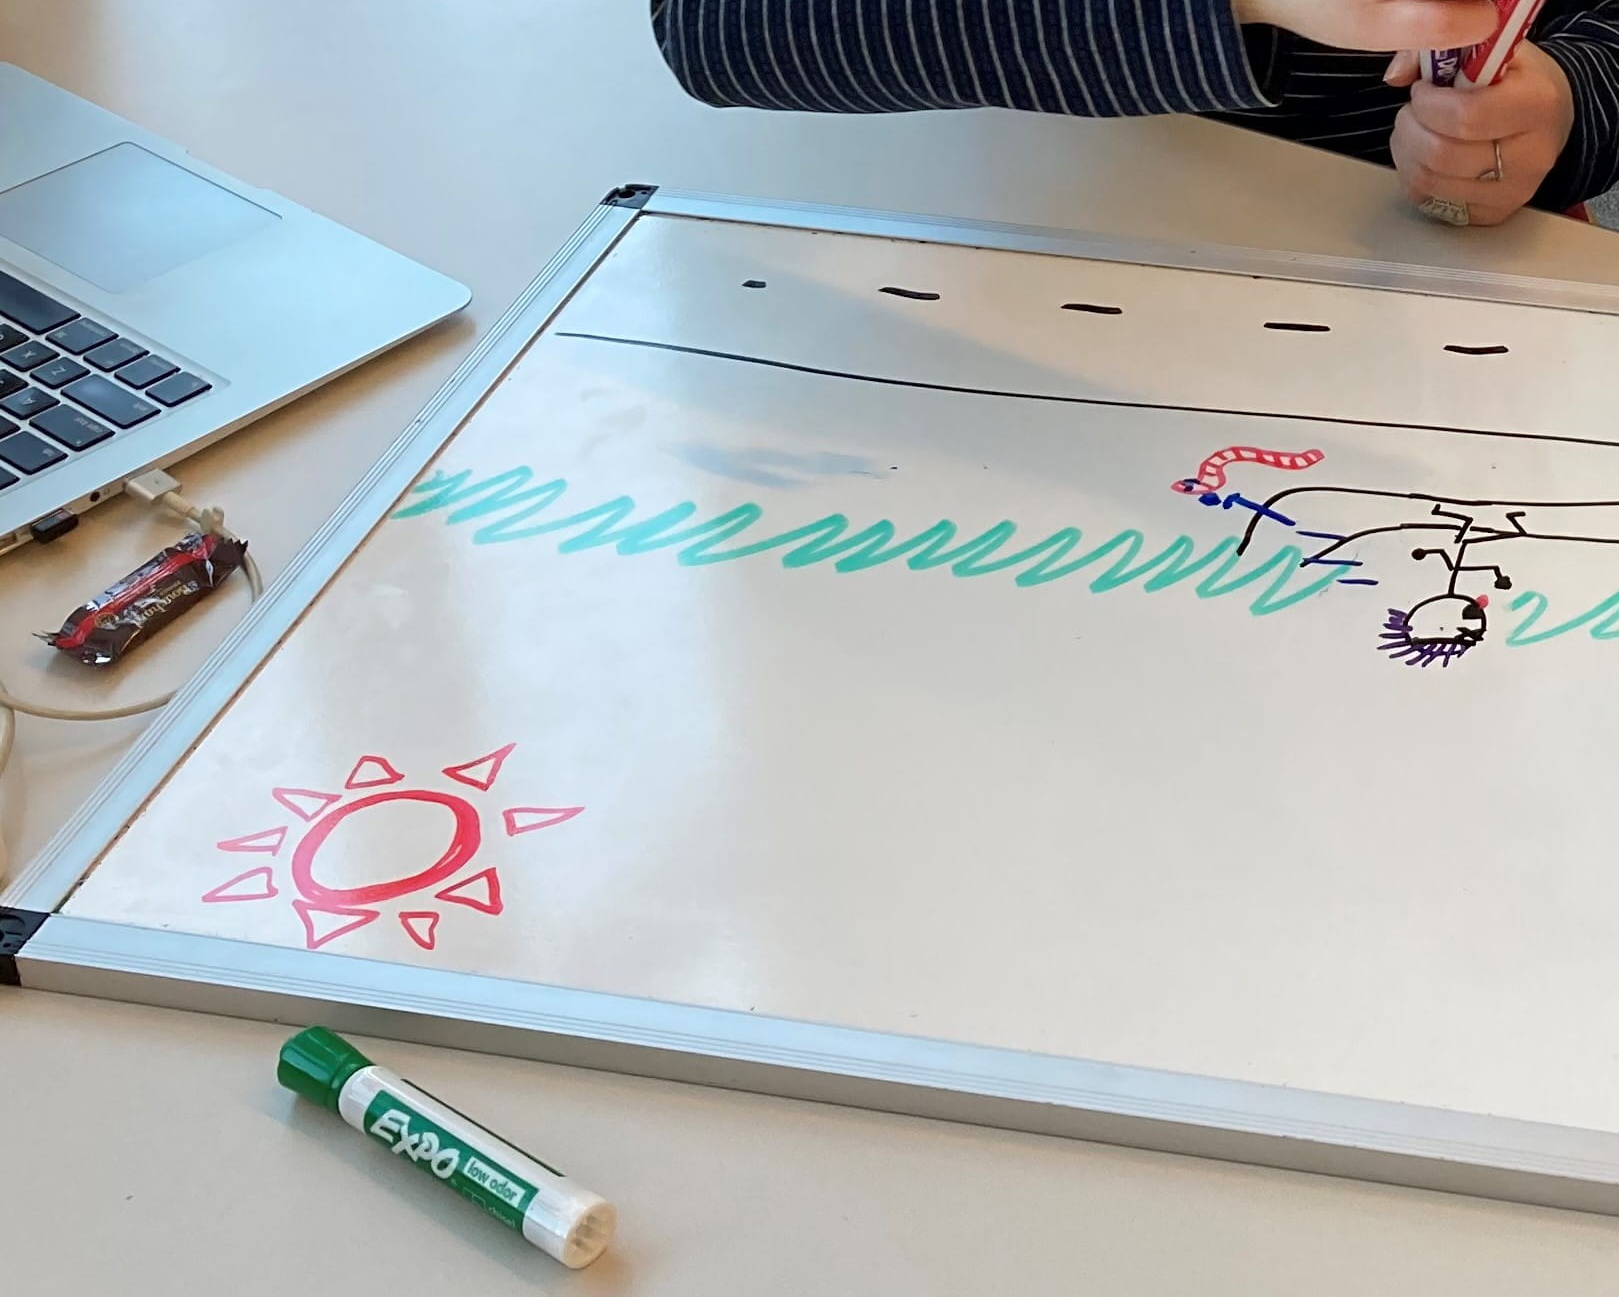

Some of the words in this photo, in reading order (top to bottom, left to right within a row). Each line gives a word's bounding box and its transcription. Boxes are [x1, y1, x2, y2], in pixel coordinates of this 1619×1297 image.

[370, 1108, 460, 1180] EXPO
[467, 1160, 491, 1184] low
[489, 1179, 518, 1202] odor
